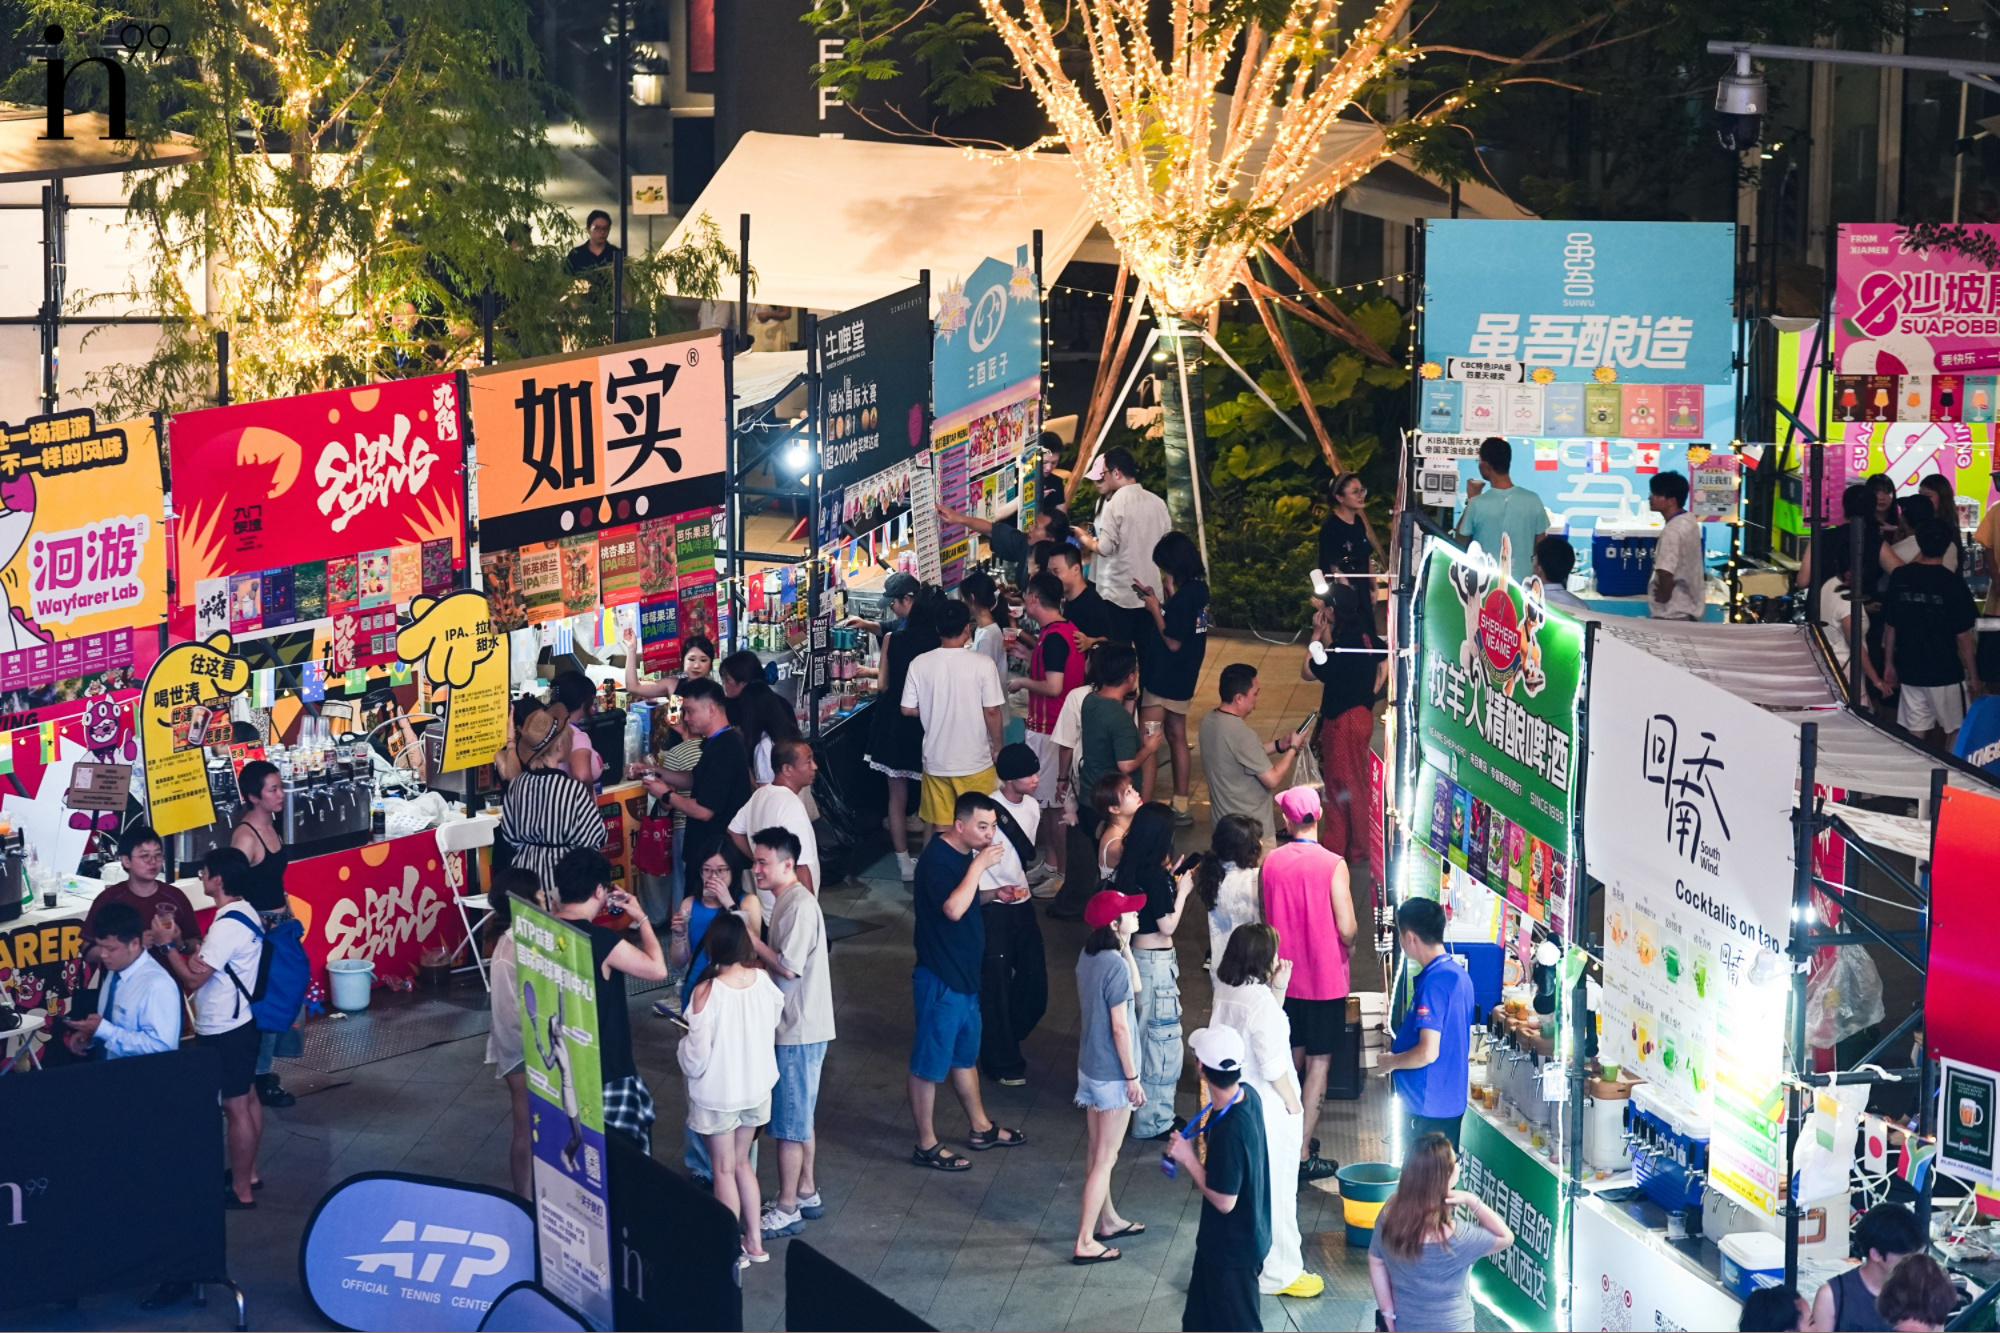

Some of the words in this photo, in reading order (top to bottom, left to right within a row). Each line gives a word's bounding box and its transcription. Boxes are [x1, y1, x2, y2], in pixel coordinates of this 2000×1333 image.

[1851, 235, 1878, 243] FROM
[1851, 246, 1889, 255] XIAMEN
[1563, 299, 1595, 307] SUIWU
[825, 319, 866, 360] 牛啤堂
[1469, 313, 1694, 369] 虽吾酿造
[1460, 361, 1512, 371] CBC特色IPA组
[514, 358, 683, 504] 如实
[1428, 437, 1481, 446] KIBA国际大赛
[0, 436, 123, 476] 不一样的风味
[34, 523, 137, 592] 洄游
[677, 537, 712, 555] IPA啤酒
[523, 559, 558, 577] 新英格兰
[602, 555, 637, 573] IPA啤酒
[523, 572, 560, 591] IPA啤酒
[37, 591, 110, 617] Wayfarer
[111, 582, 138, 603] Lab
[642, 620, 677, 639] IPA啤酒
[1481, 613, 1519, 648] SHEPHERD
[476, 635, 500, 653] 甜水
[1485, 632, 1511, 660] NEAME
[190, 653, 236, 682] 往这看
[154, 682, 200, 709] 喝世涛
[1428, 650, 1570, 793] 牧羊人精酿啤酒
[1700, 840, 1721, 862] South
[1675, 879, 1737, 931] Cocktalis
[1739, 920, 1756, 942] on
[343, 1220, 511, 1289] ATP
[341, 1278, 390, 1296] OFFICIAL
[400, 1286, 441, 1304] TENNIS
